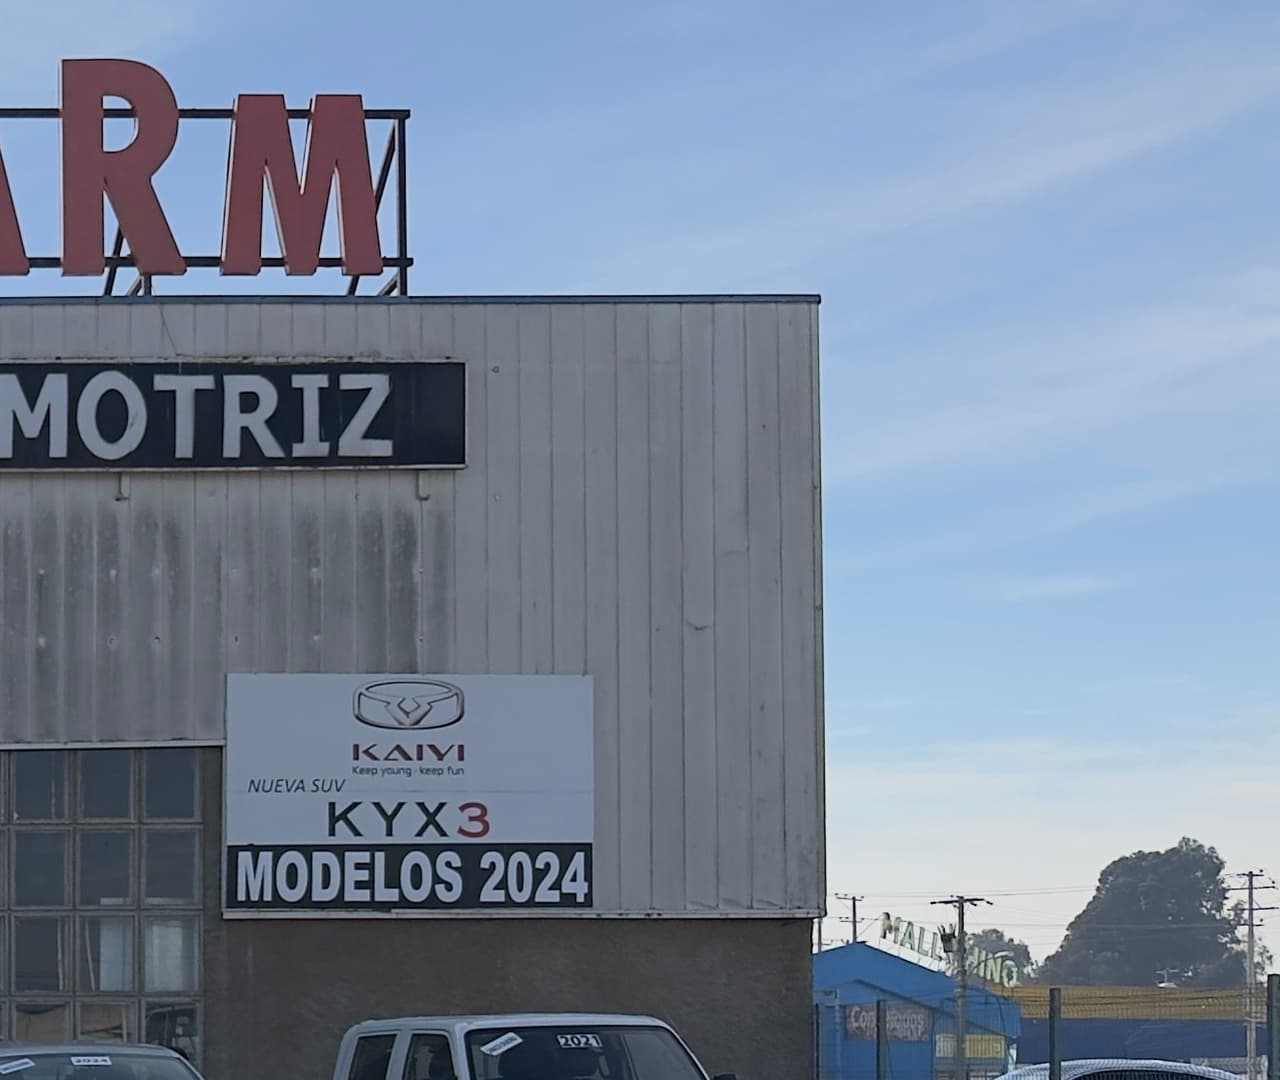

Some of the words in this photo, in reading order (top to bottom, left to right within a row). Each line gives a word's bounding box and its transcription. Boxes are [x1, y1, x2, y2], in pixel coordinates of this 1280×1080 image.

[352, 743, 465, 761] KAIYI
[352, 766, 378, 776] Keep
[380, 767, 412, 777] young
[419, 765, 444, 776] keep
[447, 765, 465, 776] fun
[248, 779, 306, 793] NUEVA
[311, 778, 346, 793] SUV
[327, 801, 491, 838] KYX3
[236, 850, 464, 903] MODELOS
[479, 850, 589, 903] 2024
[559, 1035, 603, 1047] 2021
